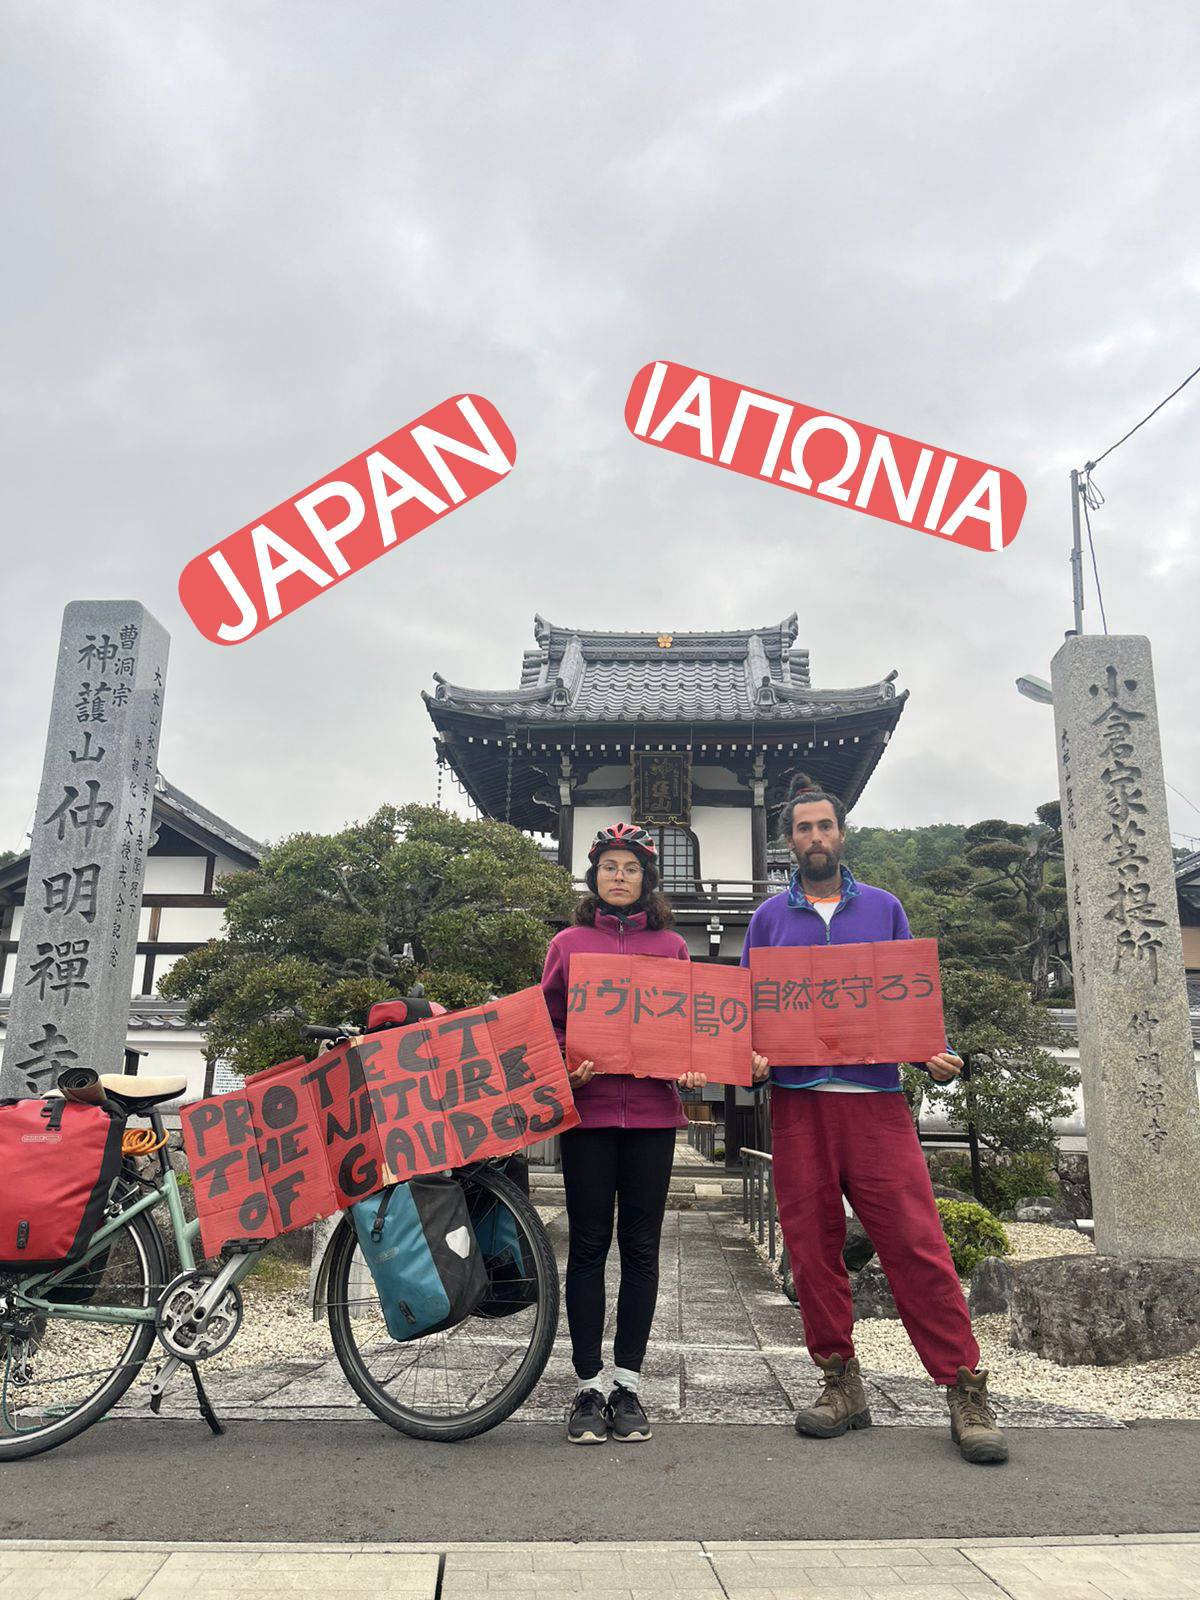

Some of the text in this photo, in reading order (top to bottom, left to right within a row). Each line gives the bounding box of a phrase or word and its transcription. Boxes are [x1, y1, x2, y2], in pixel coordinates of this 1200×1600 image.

[112, 624, 138, 707] 曹洞宗
[567, 977, 749, 1037] ガヴドス島の
[753, 973, 934, 1013] 自然を守ろう
[188, 1009, 498, 1158] PROTECT
[195, 1043, 536, 1198] THE NATURE
[238, 1085, 564, 1231] OF GAVDOS
